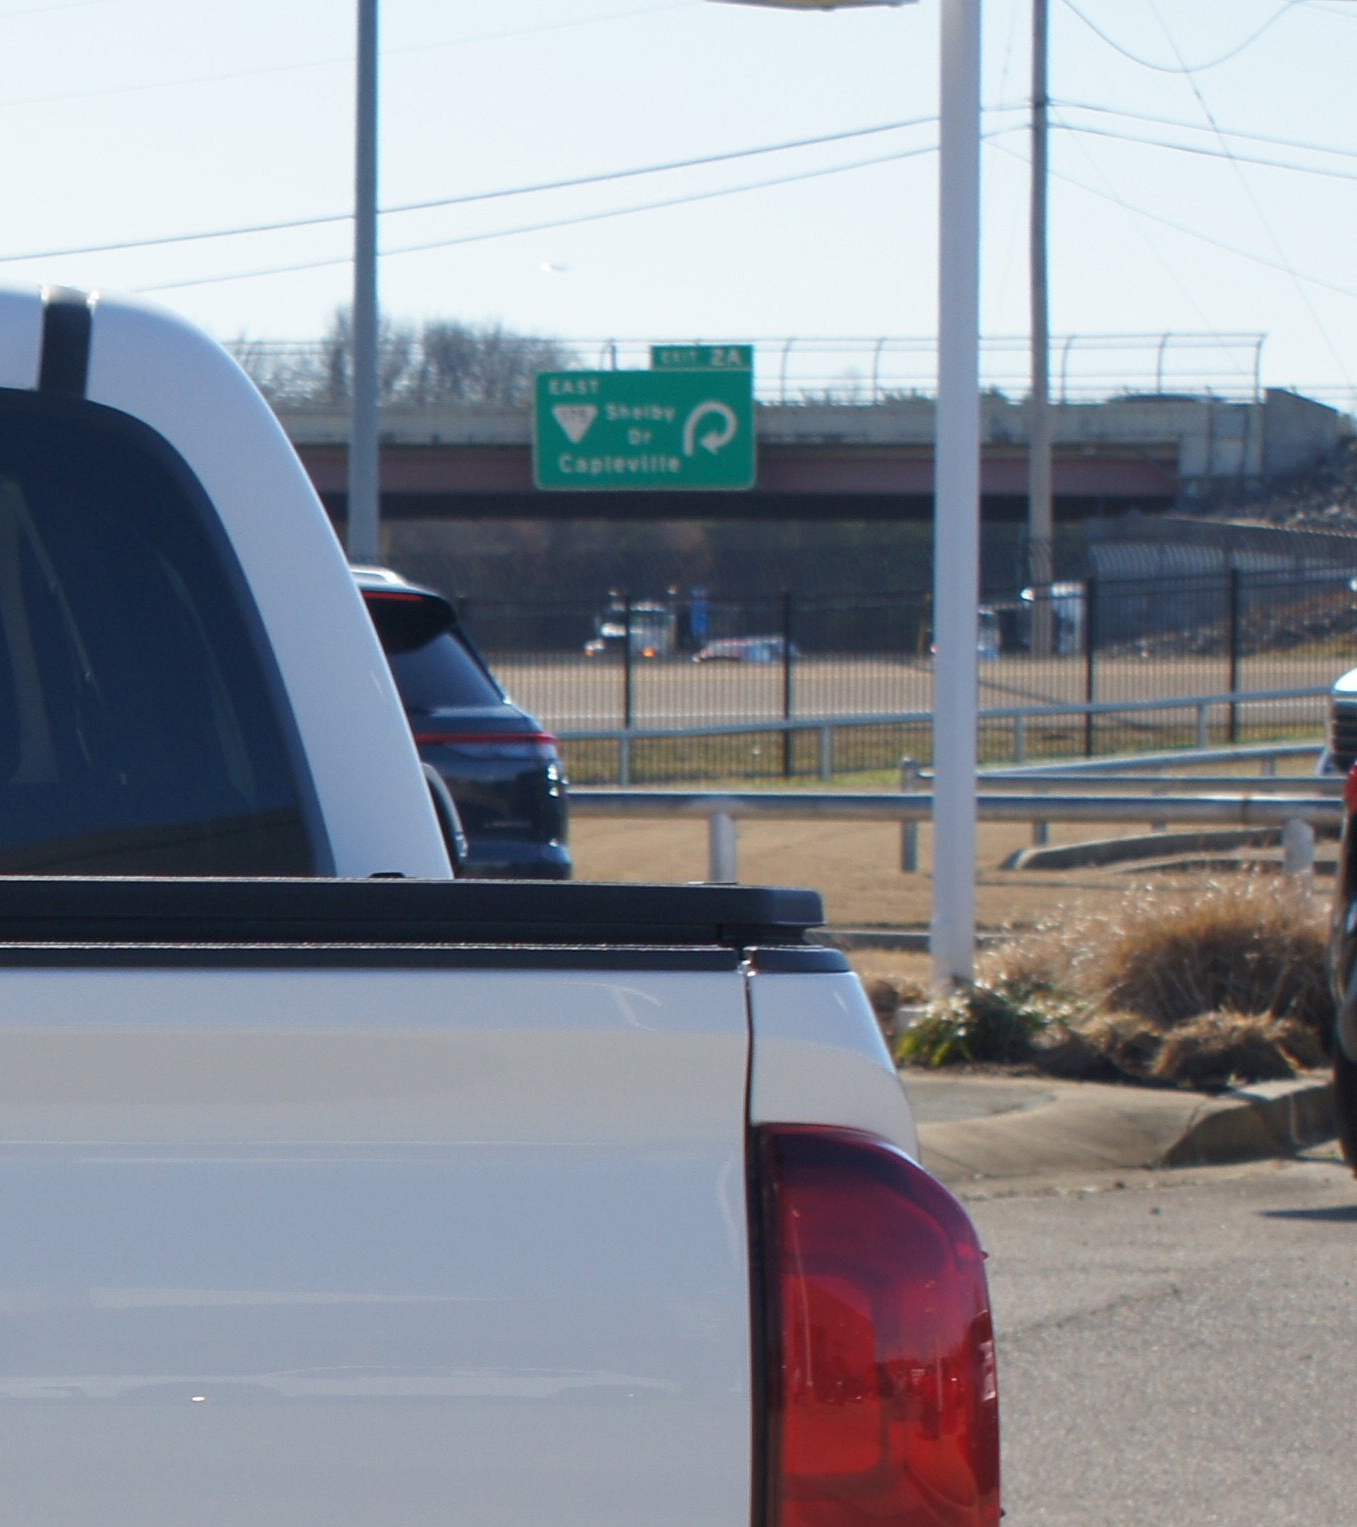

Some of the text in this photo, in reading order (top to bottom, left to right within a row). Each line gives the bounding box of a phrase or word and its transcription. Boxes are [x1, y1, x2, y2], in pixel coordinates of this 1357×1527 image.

[710, 348, 742, 366] 2A
[549, 379, 599, 395] EAST
[605, 403, 676, 423] Shelby
[628, 429, 652, 445] Dr
[559, 454, 680, 475] Capleville
